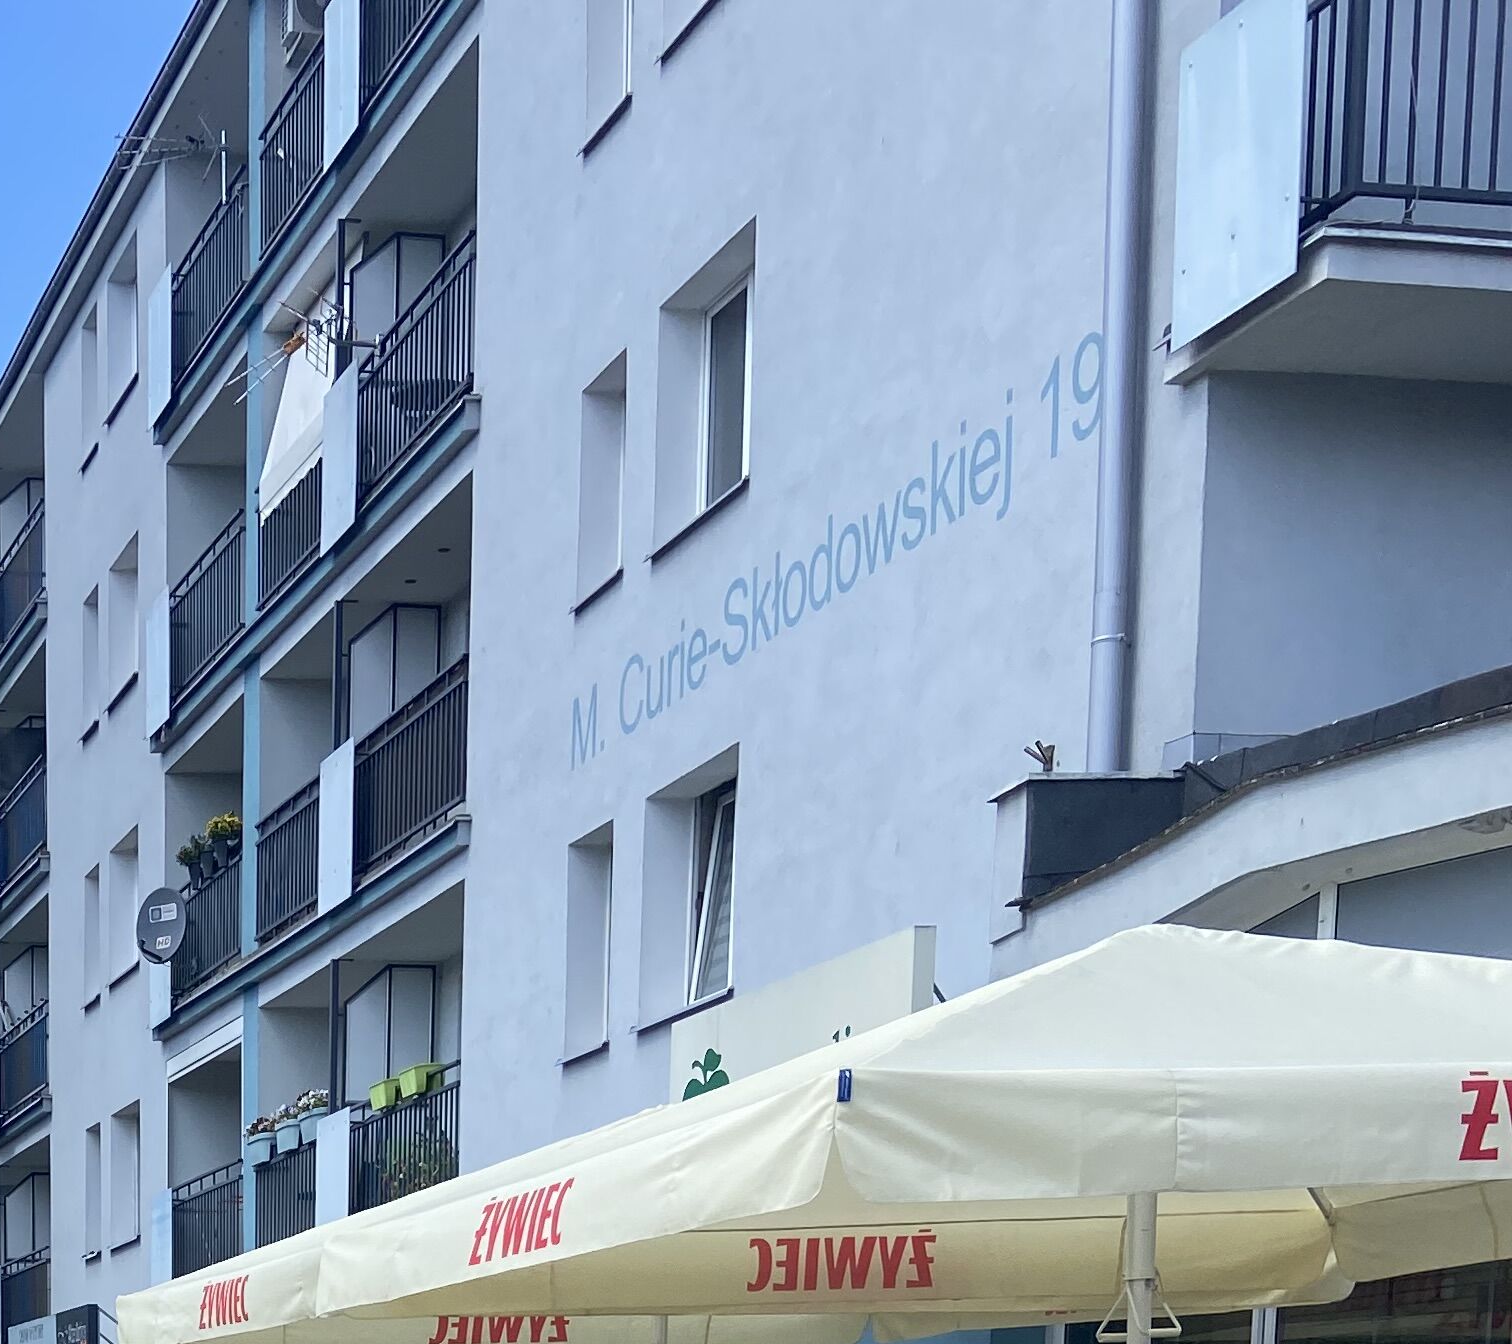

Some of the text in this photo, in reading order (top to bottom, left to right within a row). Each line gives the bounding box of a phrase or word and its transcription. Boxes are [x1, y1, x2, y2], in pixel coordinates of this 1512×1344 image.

[571, 331, 1105, 771] M. Curie-Skłodowskiej 19
[468, 1176, 576, 1266] ŻYWIEC
[198, 1275, 250, 1330] ŻYWIEC
